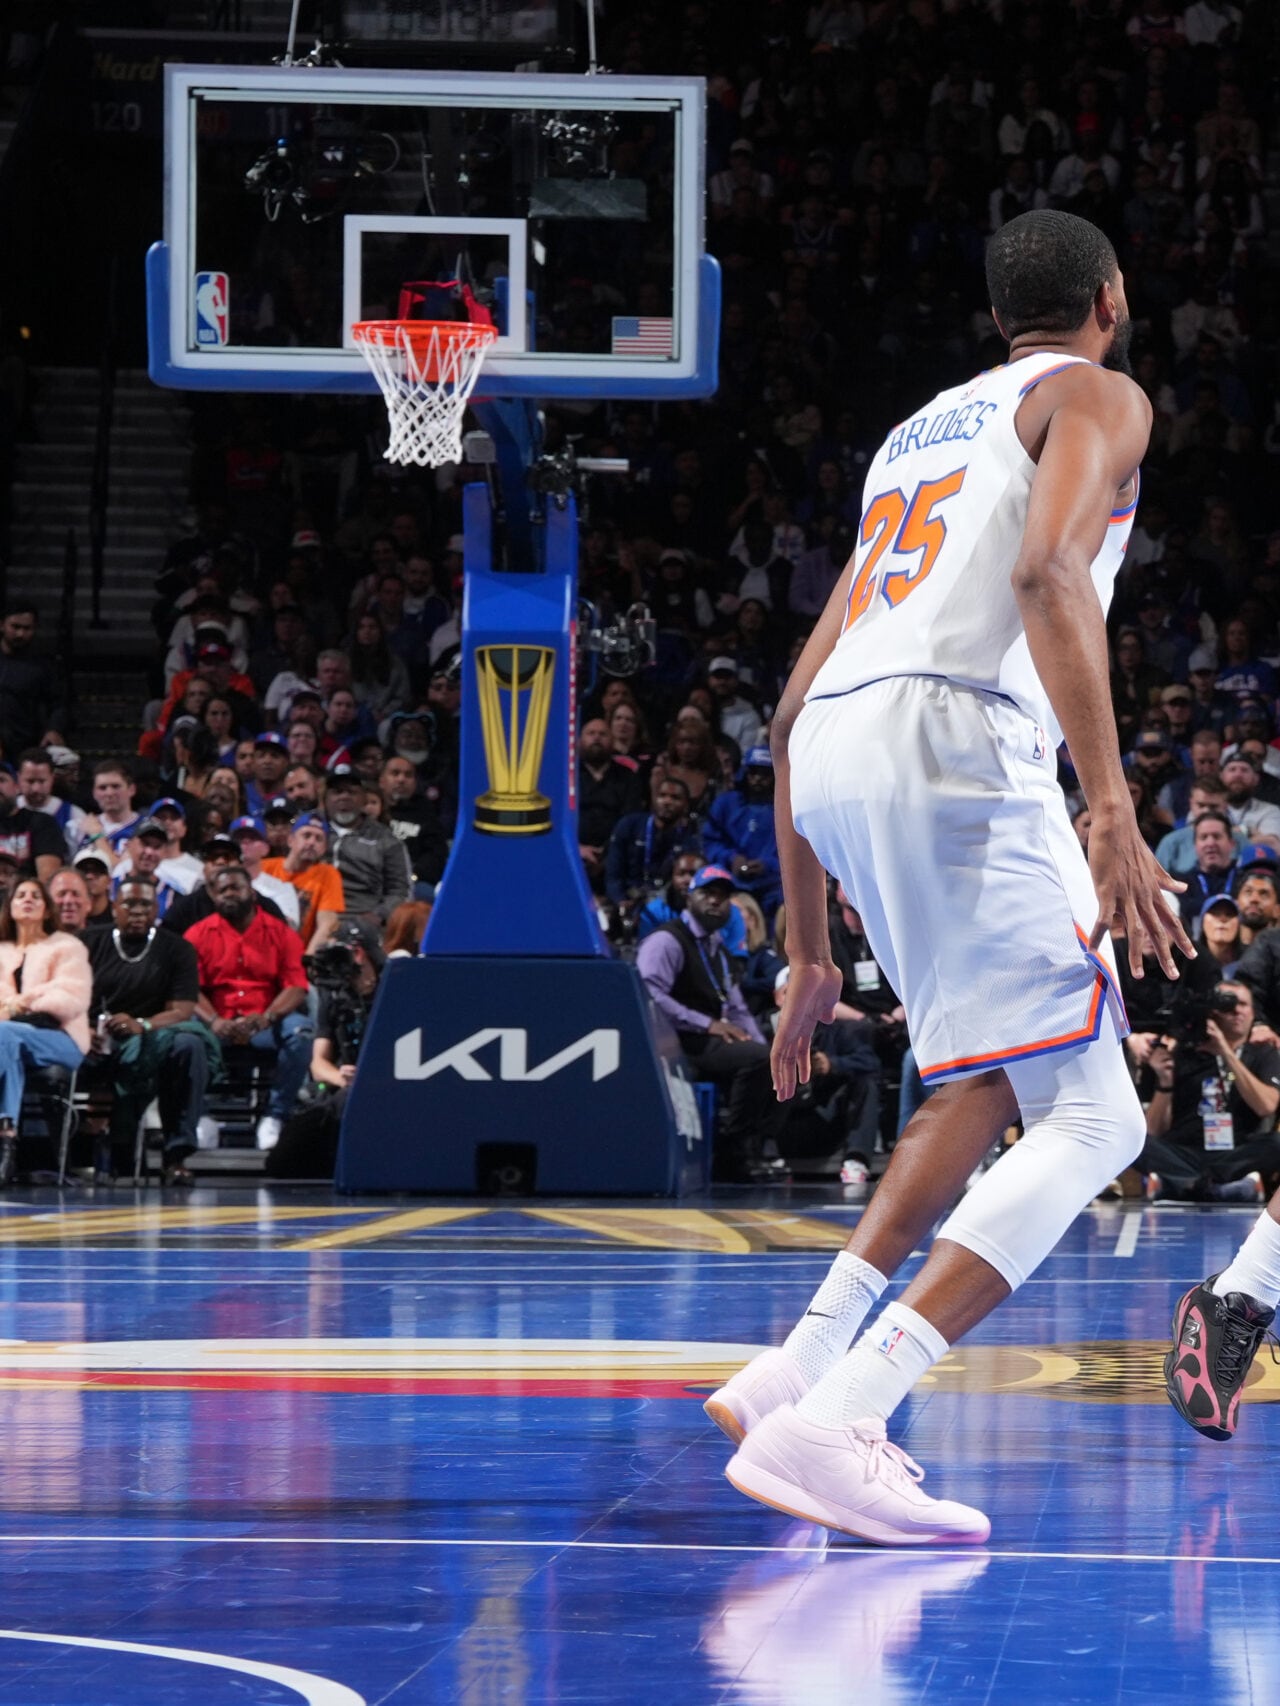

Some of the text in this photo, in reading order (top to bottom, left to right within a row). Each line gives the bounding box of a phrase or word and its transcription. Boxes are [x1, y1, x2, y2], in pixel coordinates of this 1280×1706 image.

[90, 102, 142, 130] 120
[886, 400, 997, 463] BRIDGES
[846, 464, 968, 630] 25
[394, 1027, 620, 1082] KIA
